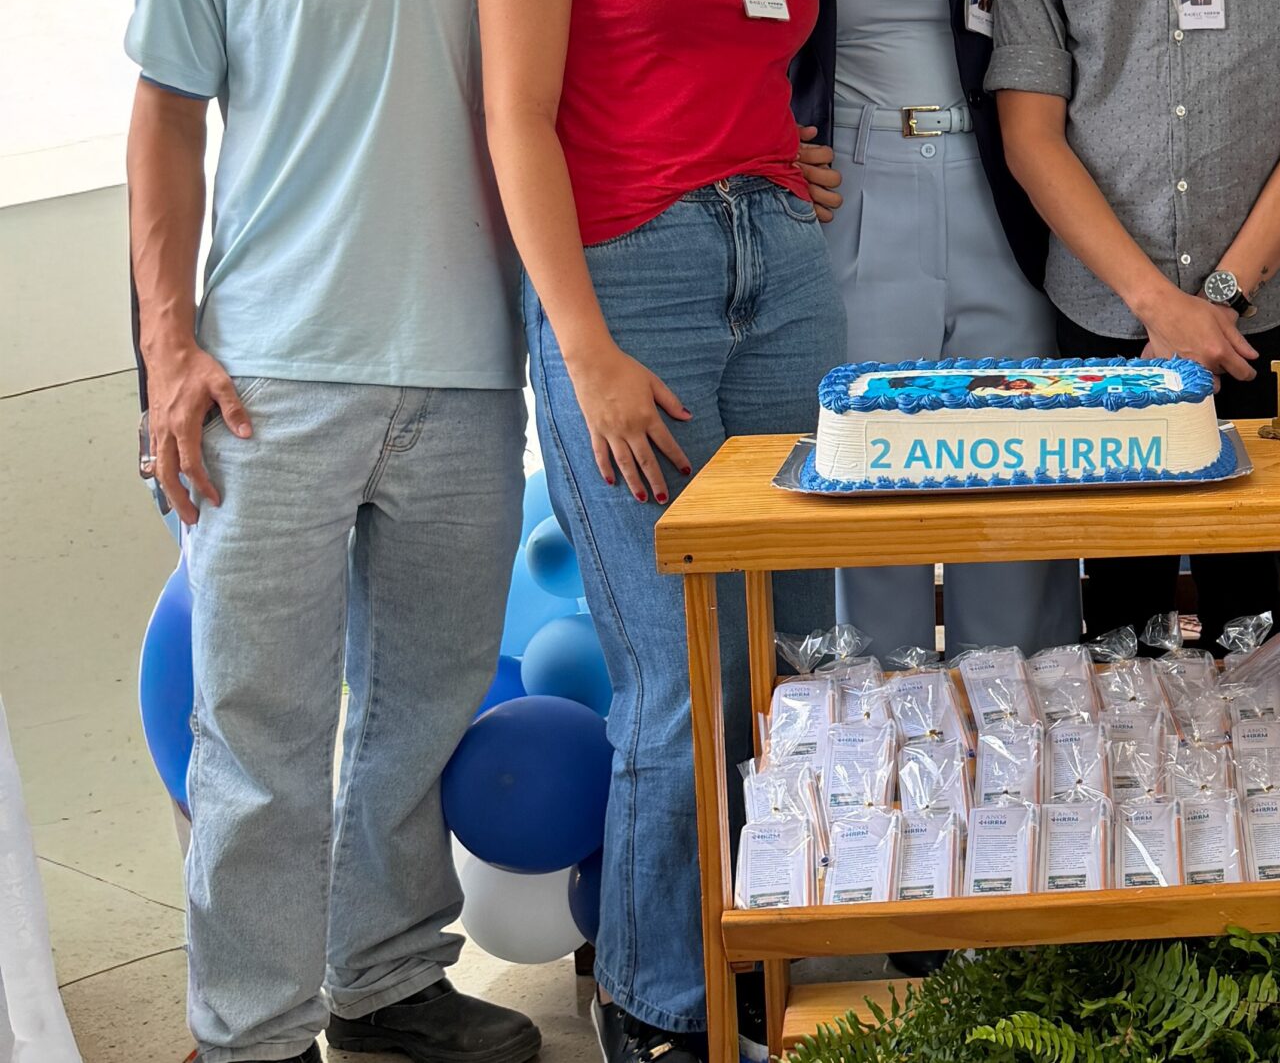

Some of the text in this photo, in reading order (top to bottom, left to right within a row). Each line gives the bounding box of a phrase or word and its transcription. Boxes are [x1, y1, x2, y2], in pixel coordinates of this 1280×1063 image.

[870, 436, 1162, 470] 2 ANOS HRRM
